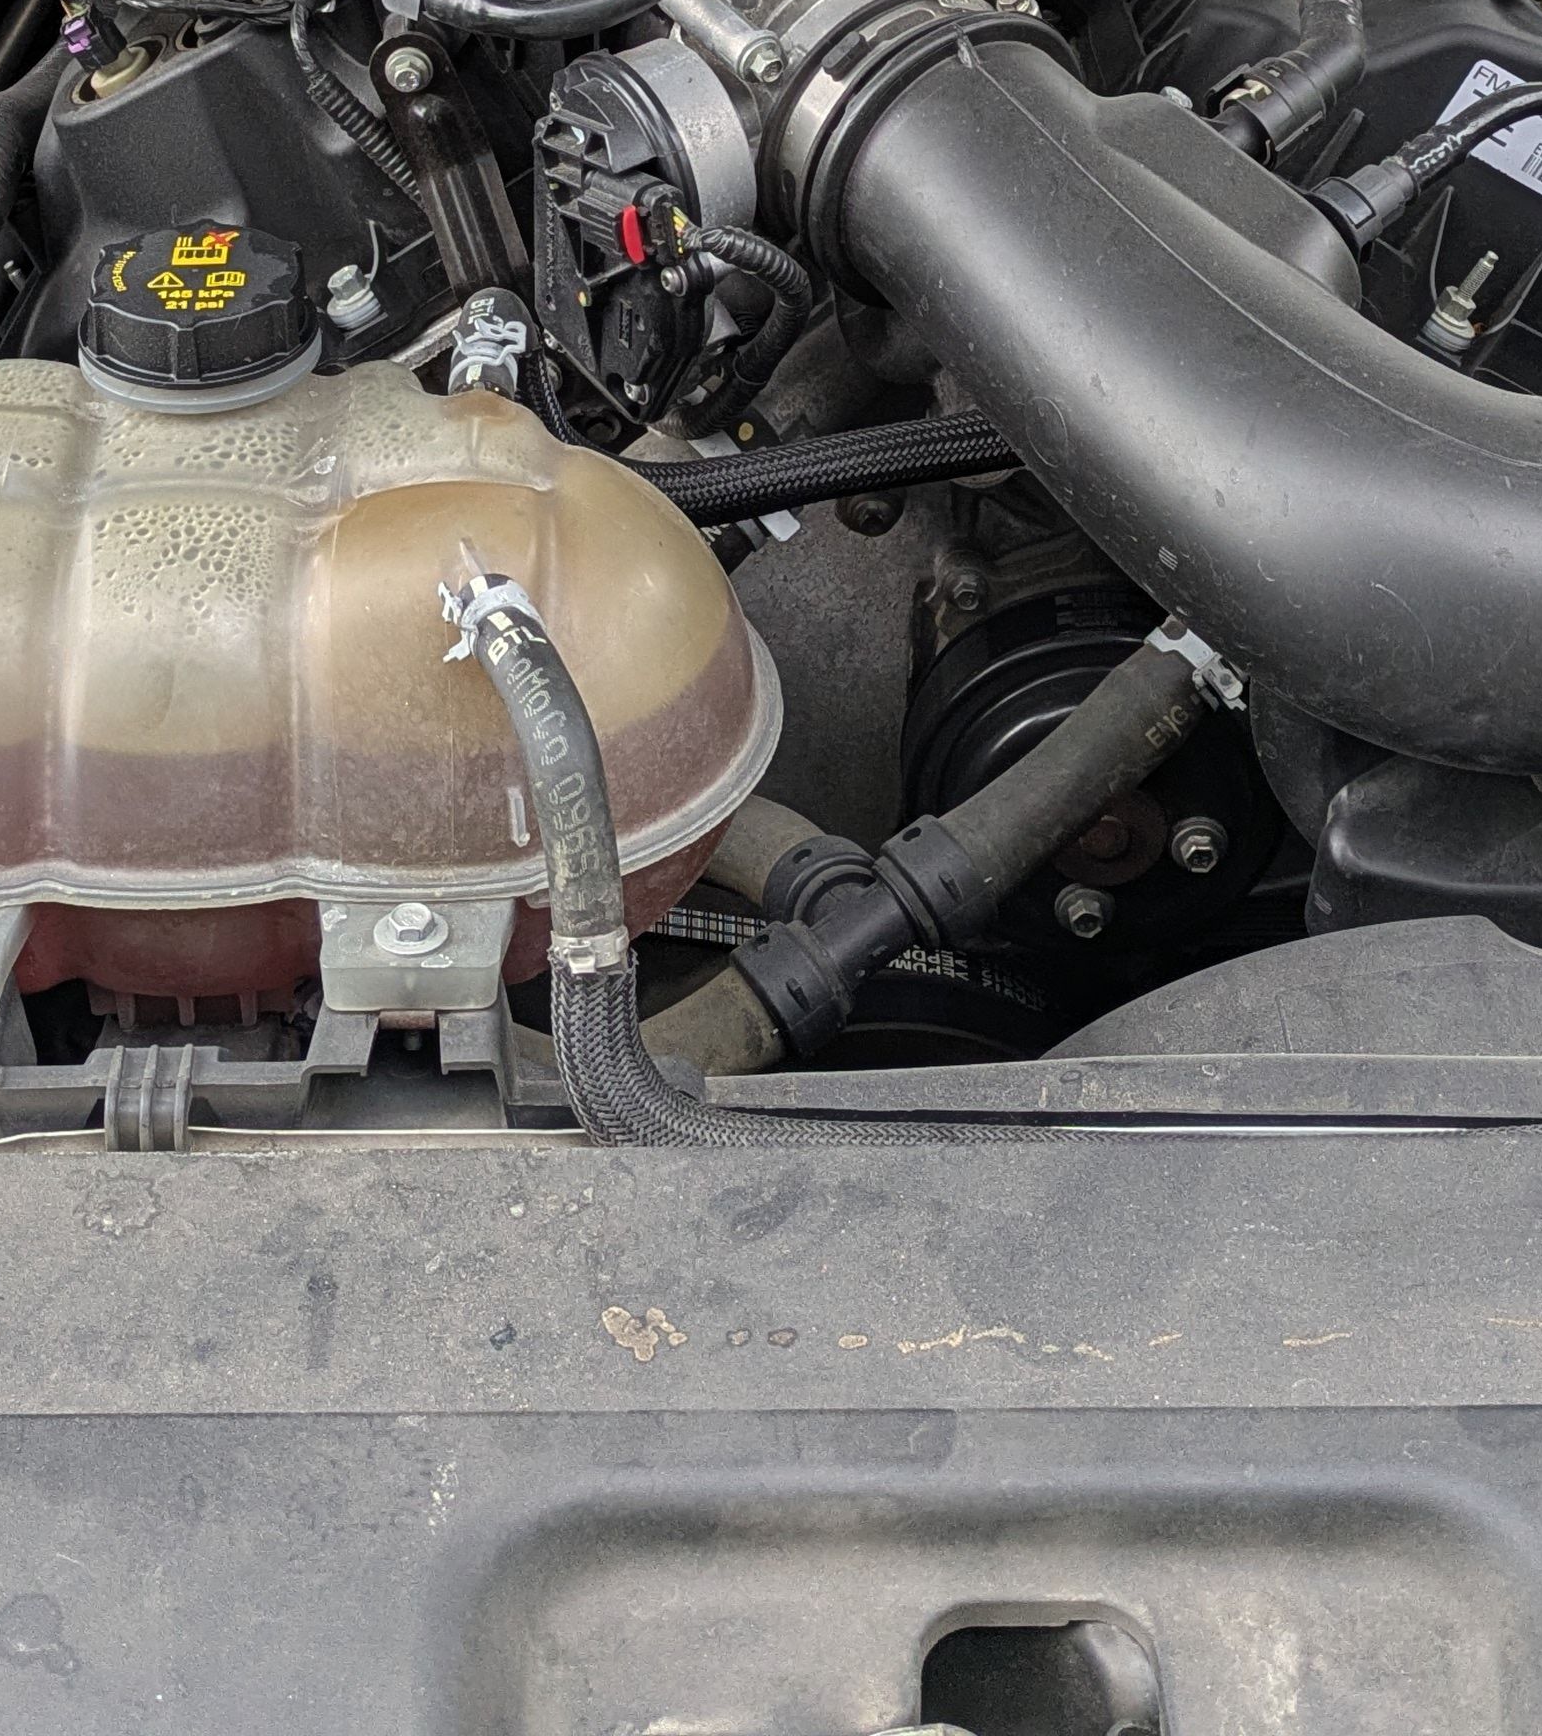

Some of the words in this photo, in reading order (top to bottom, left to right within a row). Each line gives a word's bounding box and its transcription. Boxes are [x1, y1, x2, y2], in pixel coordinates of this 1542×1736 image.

[157, 289, 193, 299] 145
[198, 289, 235, 298] kPa
[165, 301, 188, 309] 21
[194, 300, 225, 311] psi
[487, 625, 548, 666] BTL
[1144, 704, 1189, 750] ENG
